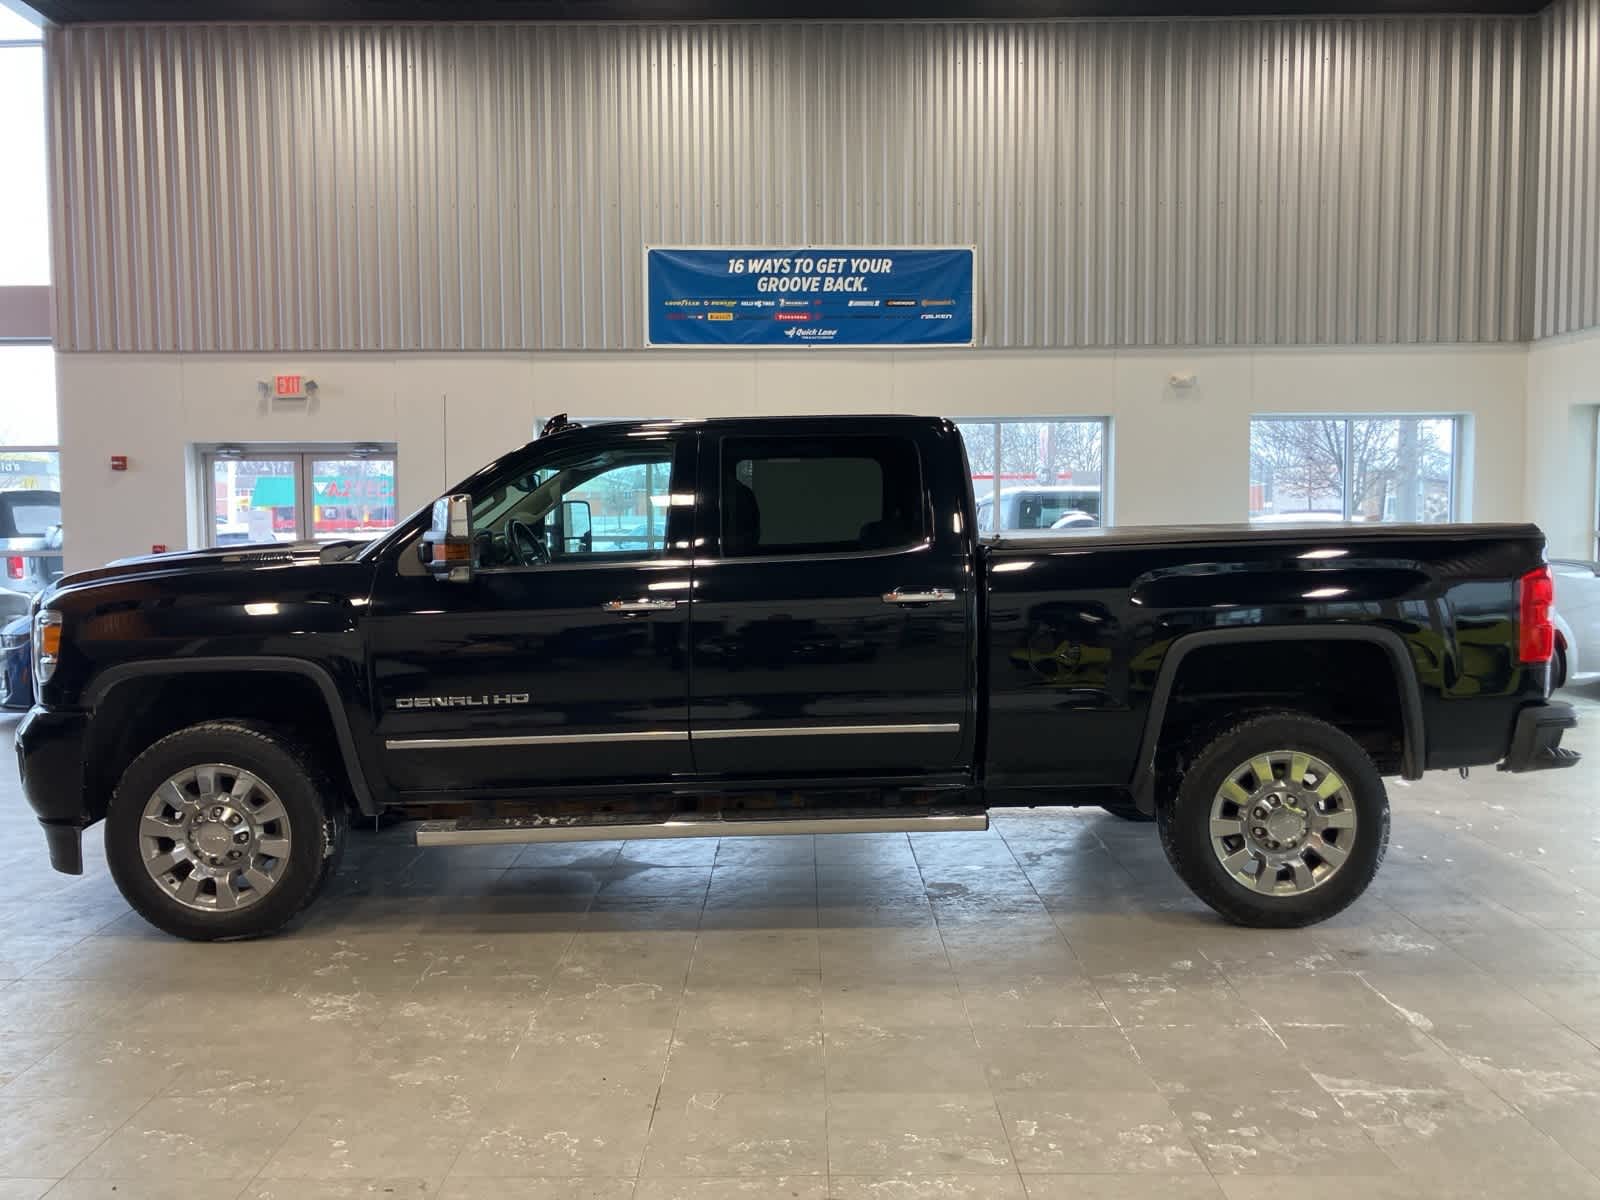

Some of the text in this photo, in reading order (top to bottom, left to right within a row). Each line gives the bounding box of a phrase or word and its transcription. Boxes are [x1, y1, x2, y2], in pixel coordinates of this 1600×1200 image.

[728, 258, 893, 274] 16 WAYS TO GET YOUR
[757, 276, 868, 292] GROOVE BACK.
[796, 328, 818, 336] Quick
[277, 375, 301, 395] EXIT
[396, 694, 529, 708] DENALI HD
